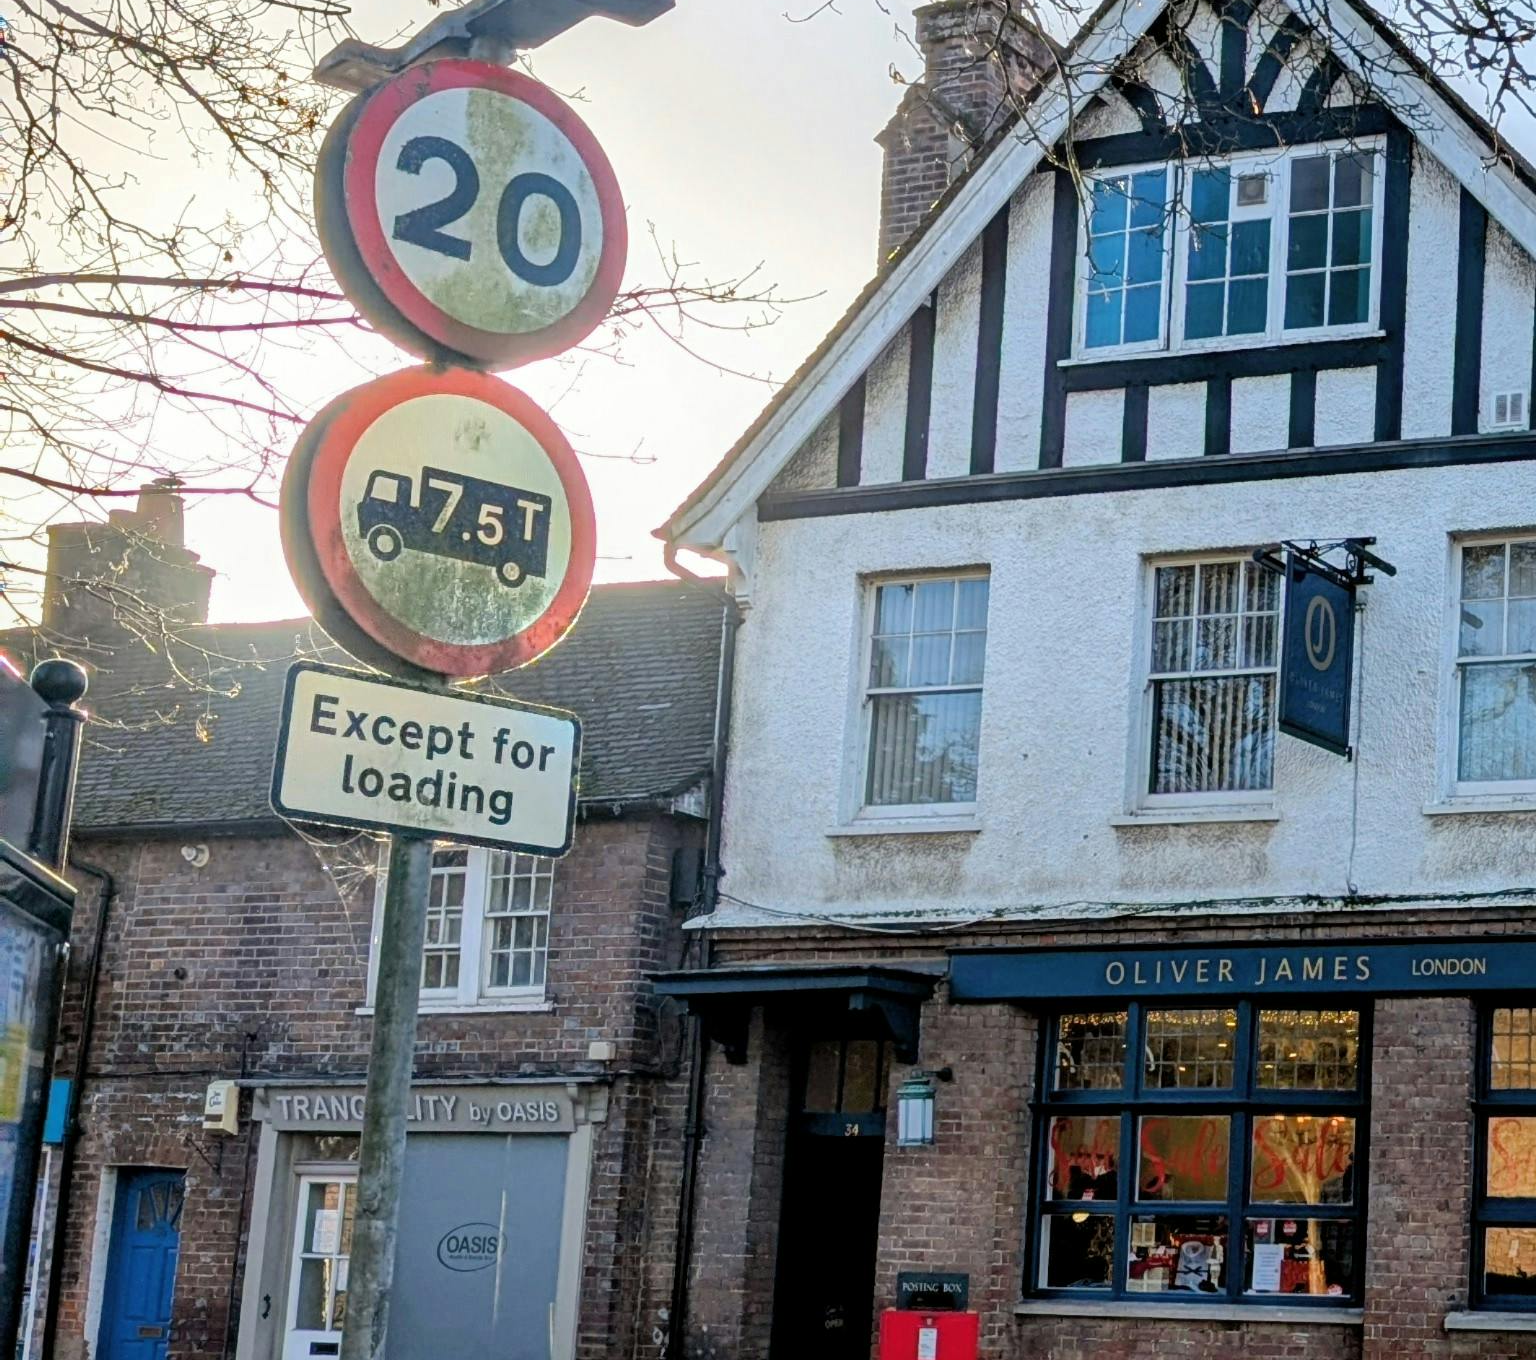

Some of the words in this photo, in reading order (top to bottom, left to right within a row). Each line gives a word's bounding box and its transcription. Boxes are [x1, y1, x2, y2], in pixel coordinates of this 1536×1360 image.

[392, 136, 582, 287] 20
[310, 693, 475, 760] Except
[493, 727, 555, 772] for
[342, 754, 514, 826] loading
[1105, 959, 1235, 985] OLIVER
[1255, 955, 1371, 985] JAMES
[1412, 957, 1487, 977] LONDON
[469, 1103, 492, 1126] by
[498, 1100, 559, 1123] OASIS
[1140, 1118, 1225, 1192] Sale
[1254, 1118, 1351, 1190] Sale
[446, 1235, 498, 1254] OASIS
[902, 1282, 939, 1292] POSTING
[943, 1282, 962, 1293] BOX
